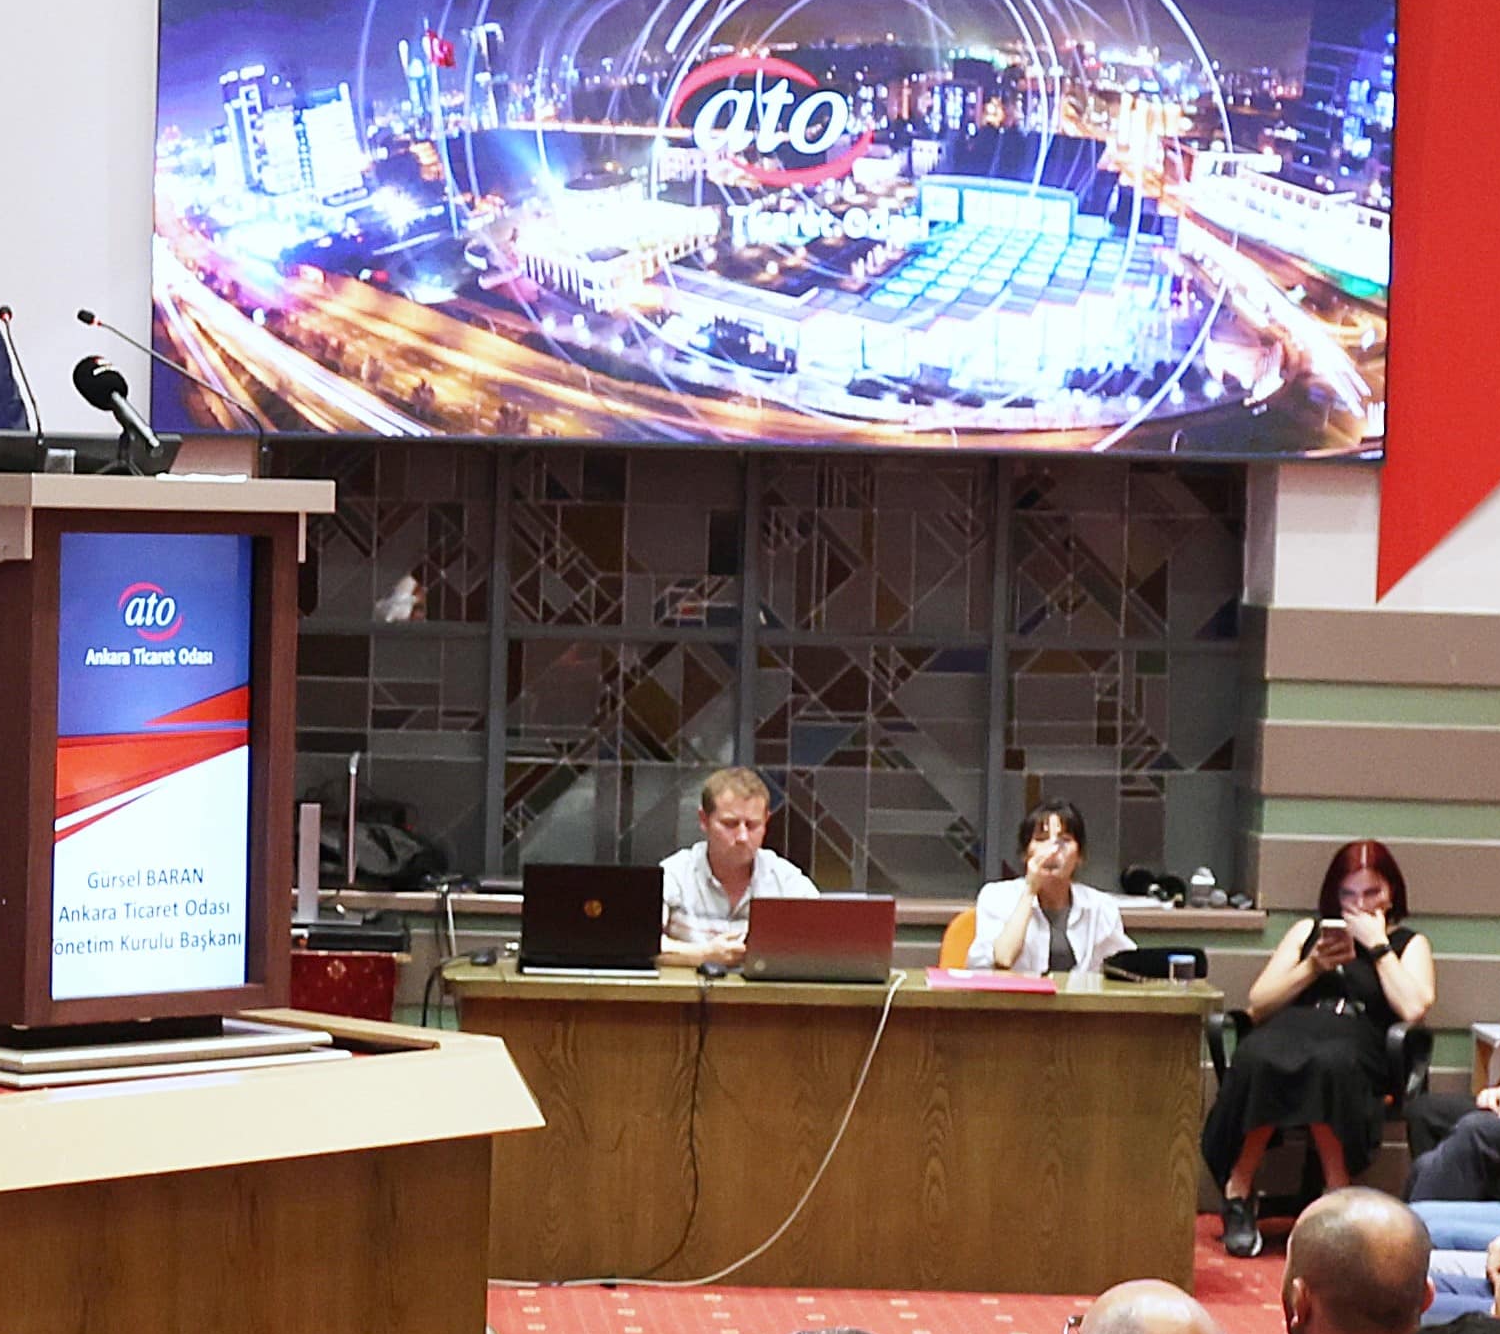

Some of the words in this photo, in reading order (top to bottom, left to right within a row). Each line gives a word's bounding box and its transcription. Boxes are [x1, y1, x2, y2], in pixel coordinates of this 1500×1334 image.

[693, 77, 850, 155] ato
[124, 592, 176, 627] ato
[85, 647, 131, 665] Ankara
[133, 647, 176, 665] Ticaret
[178, 647, 213, 665] Odası
[147, 867, 204, 886] BARAN
[58, 904, 117, 923] Ankara
[124, 901, 179, 919] Ticaret
[185, 898, 231, 917] Odası
[52, 938, 114, 955] önetim
[120, 931, 174, 951] Kurulu
[180, 928, 242, 952] Başkanı
